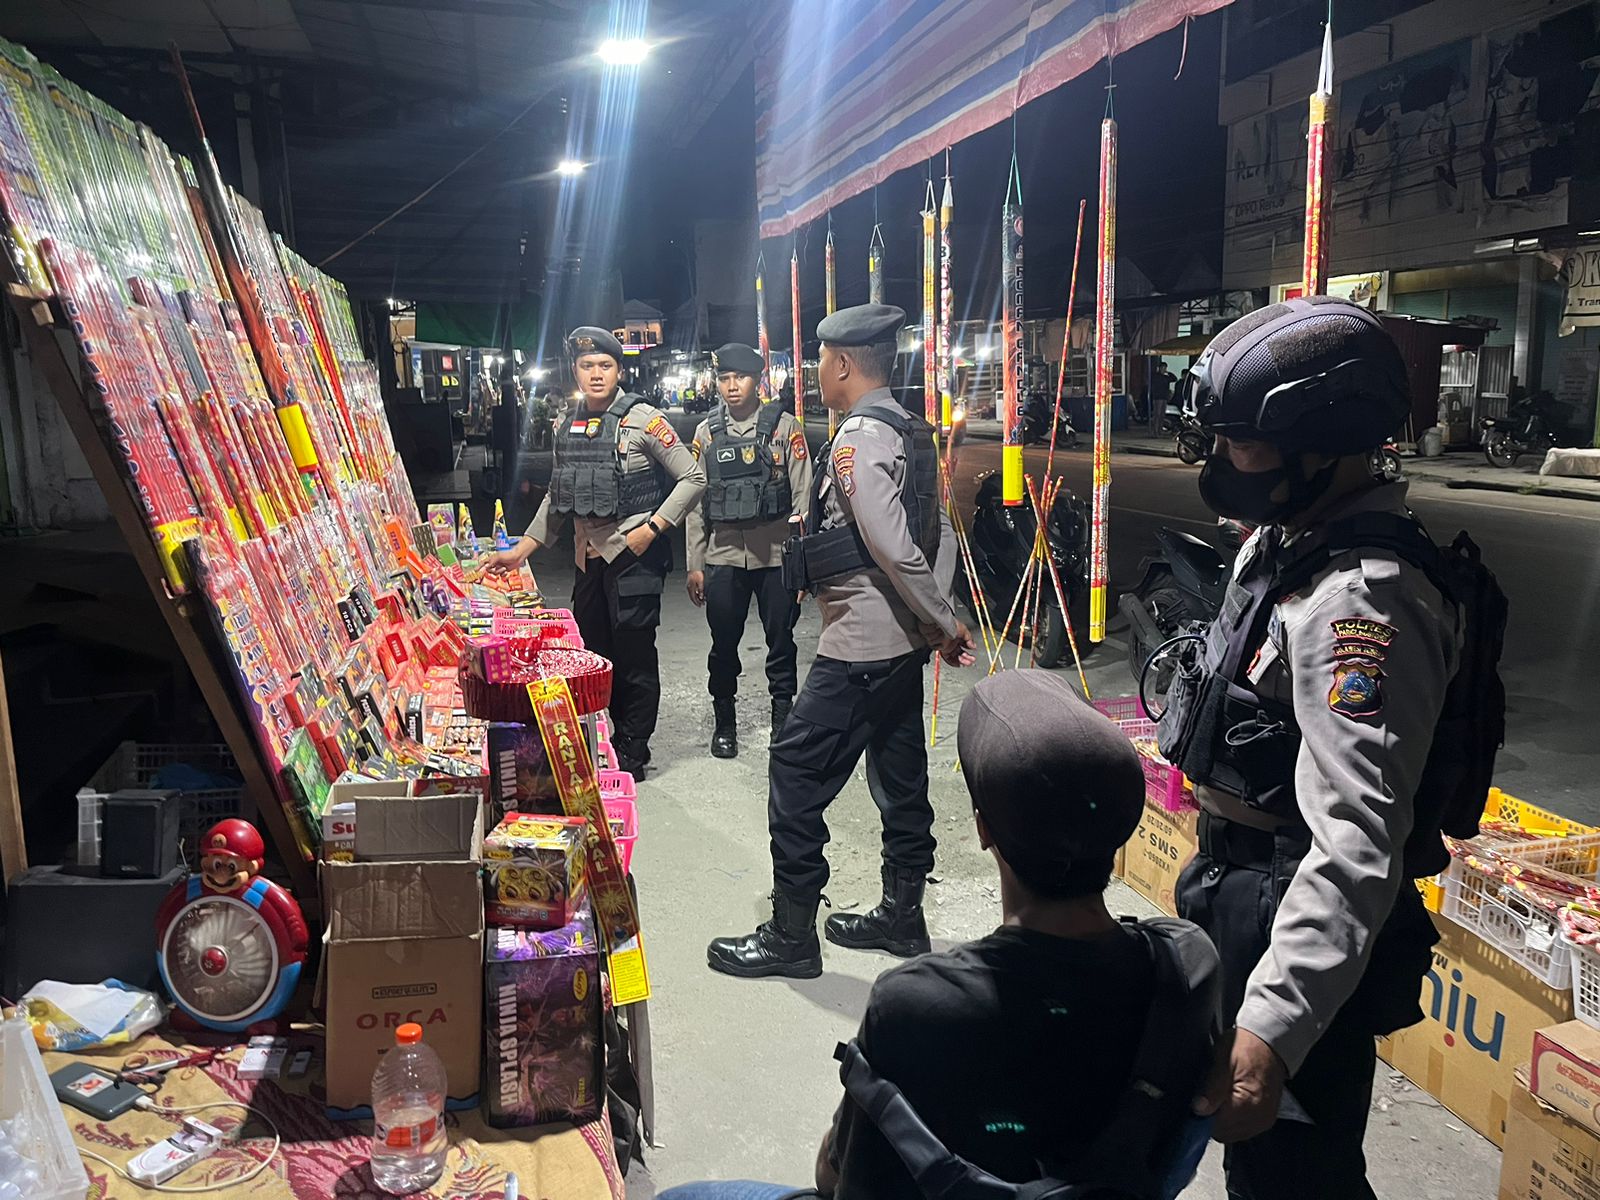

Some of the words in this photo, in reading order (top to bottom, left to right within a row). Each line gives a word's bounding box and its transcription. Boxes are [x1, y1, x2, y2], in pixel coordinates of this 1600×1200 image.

[344, 618, 354, 634] PCS
[1334, 619, 1394, 638] POLRES
[500, 750, 518, 799] NINJA
[552, 721, 584, 799] RANTAI
[1149, 832, 1179, 861] SMS
[355, 1007, 448, 1030] ORCA
[498, 983, 518, 1037] NINJA
[499, 1037, 519, 1107] SPLASH
